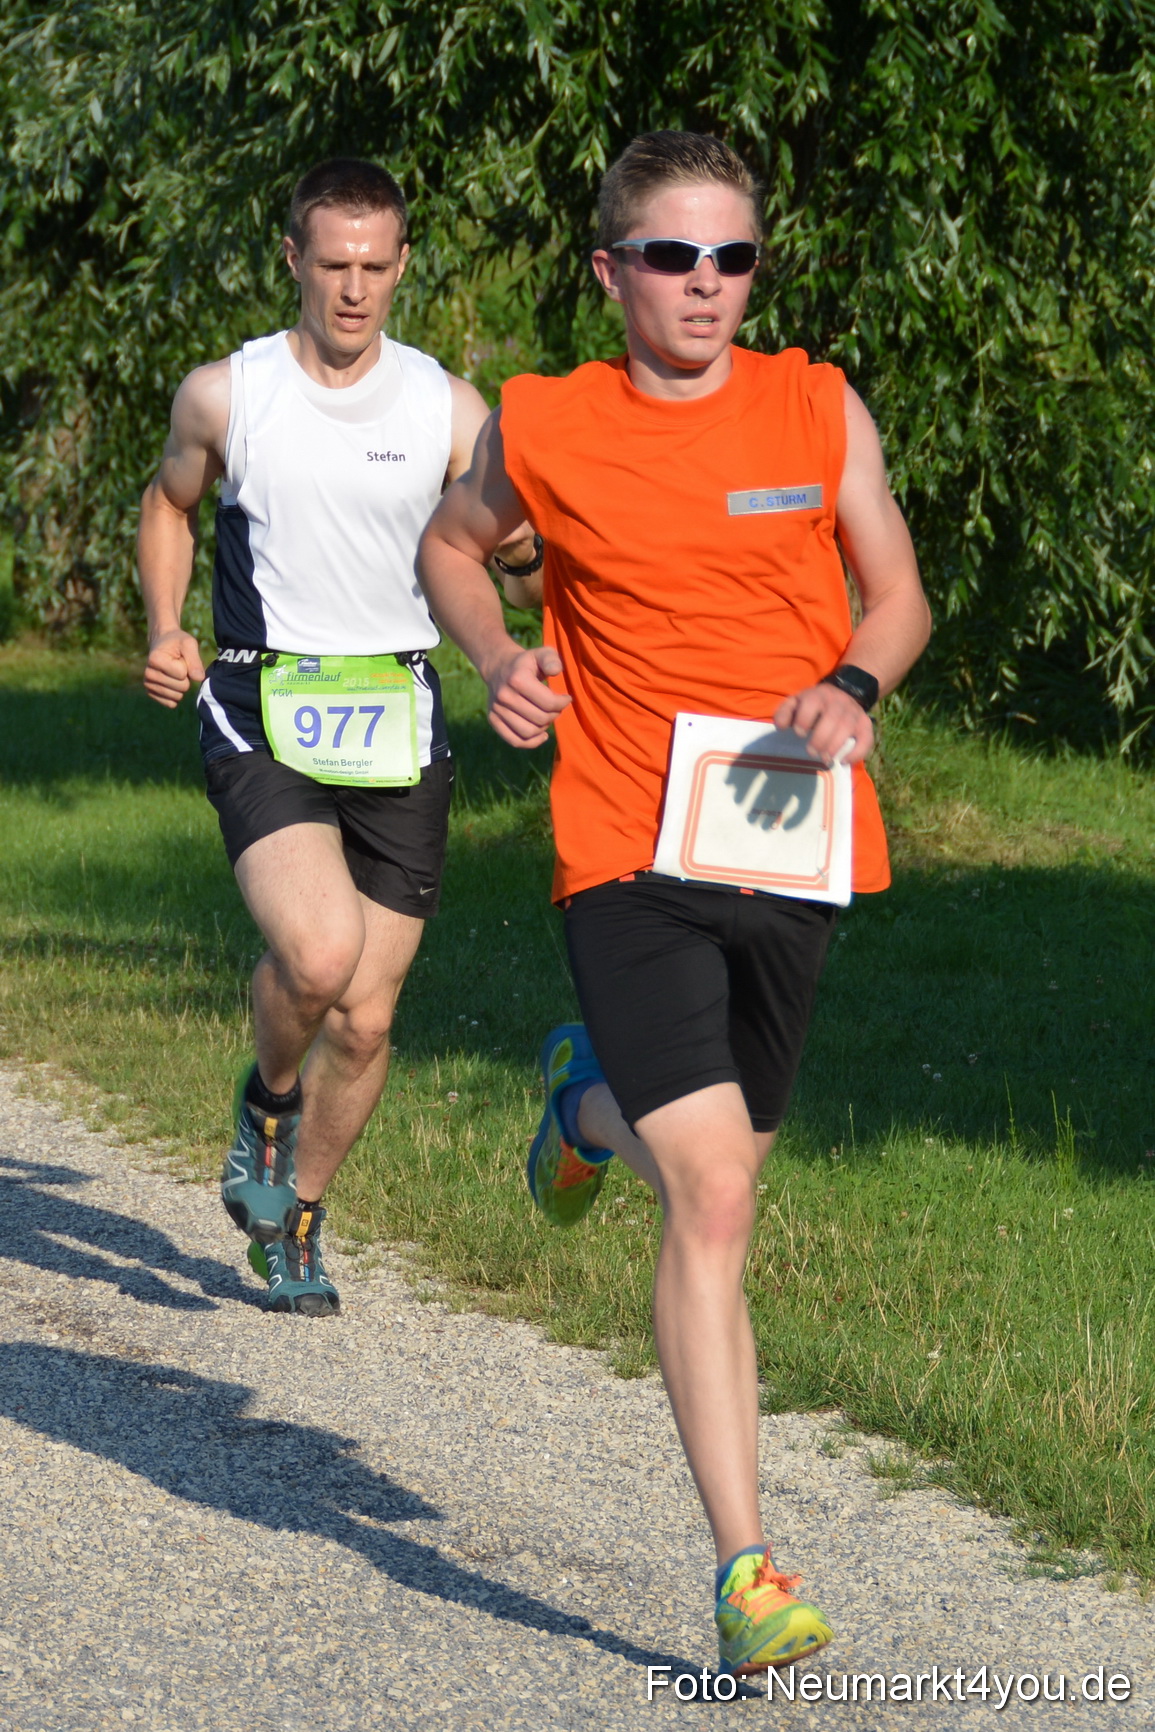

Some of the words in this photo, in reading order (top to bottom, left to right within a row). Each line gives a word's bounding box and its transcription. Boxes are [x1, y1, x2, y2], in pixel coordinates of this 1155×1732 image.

[366, 450, 406, 462] Stefan
[286, 671, 342, 682] firmenlauf
[293, 705, 386, 749] 977
[312, 757, 340, 767] Stefan
[340, 758, 374, 768] Bergler
